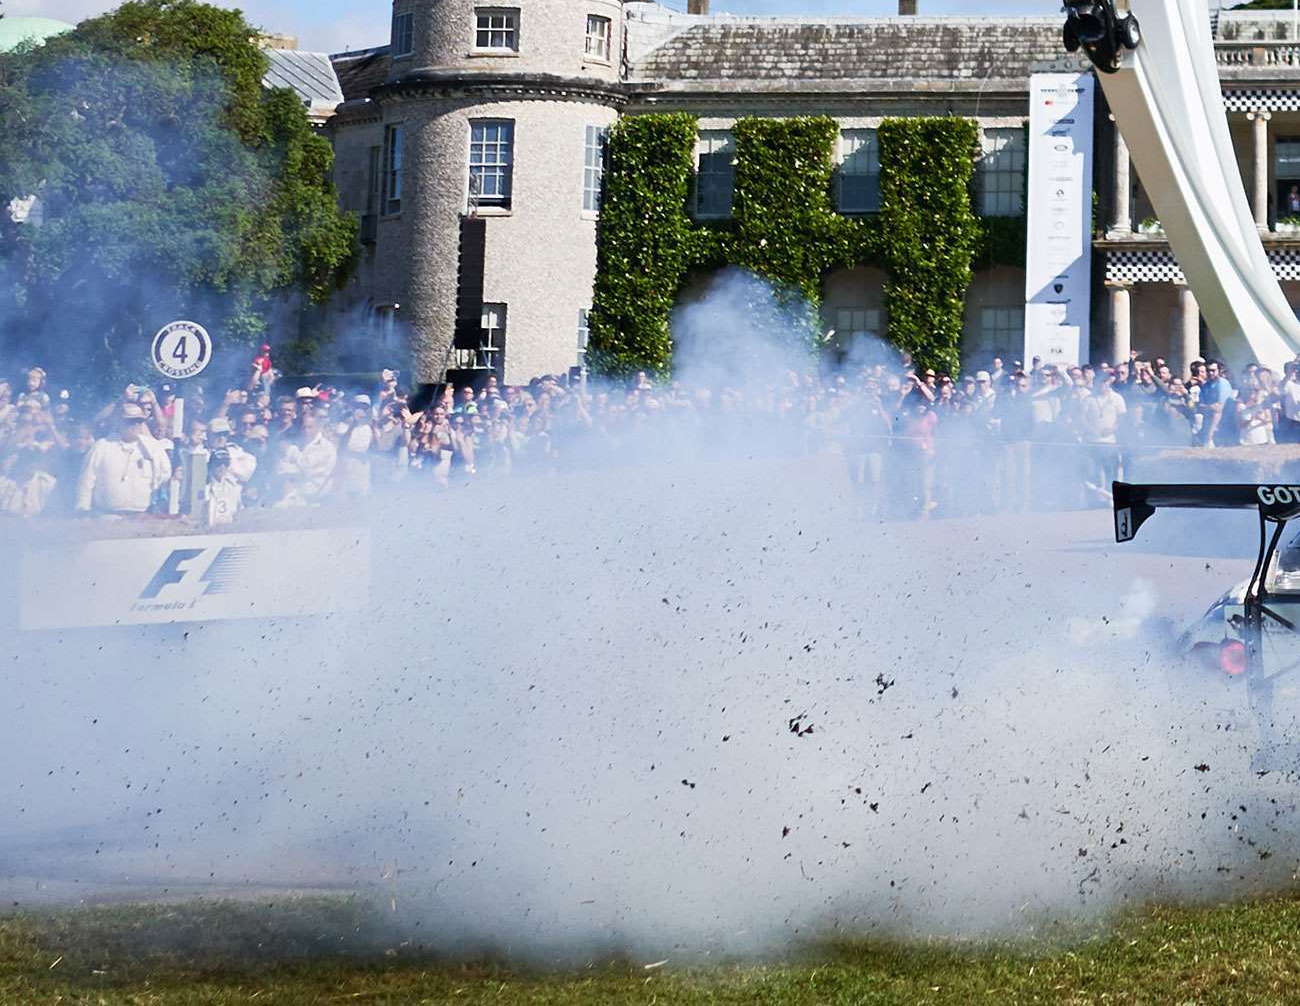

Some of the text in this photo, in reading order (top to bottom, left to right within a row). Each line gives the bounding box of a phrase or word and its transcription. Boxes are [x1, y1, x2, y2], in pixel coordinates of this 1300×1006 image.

[172, 336, 188, 363] 4
[138, 546, 250, 599] F1
[129, 600, 185, 611] Formula
